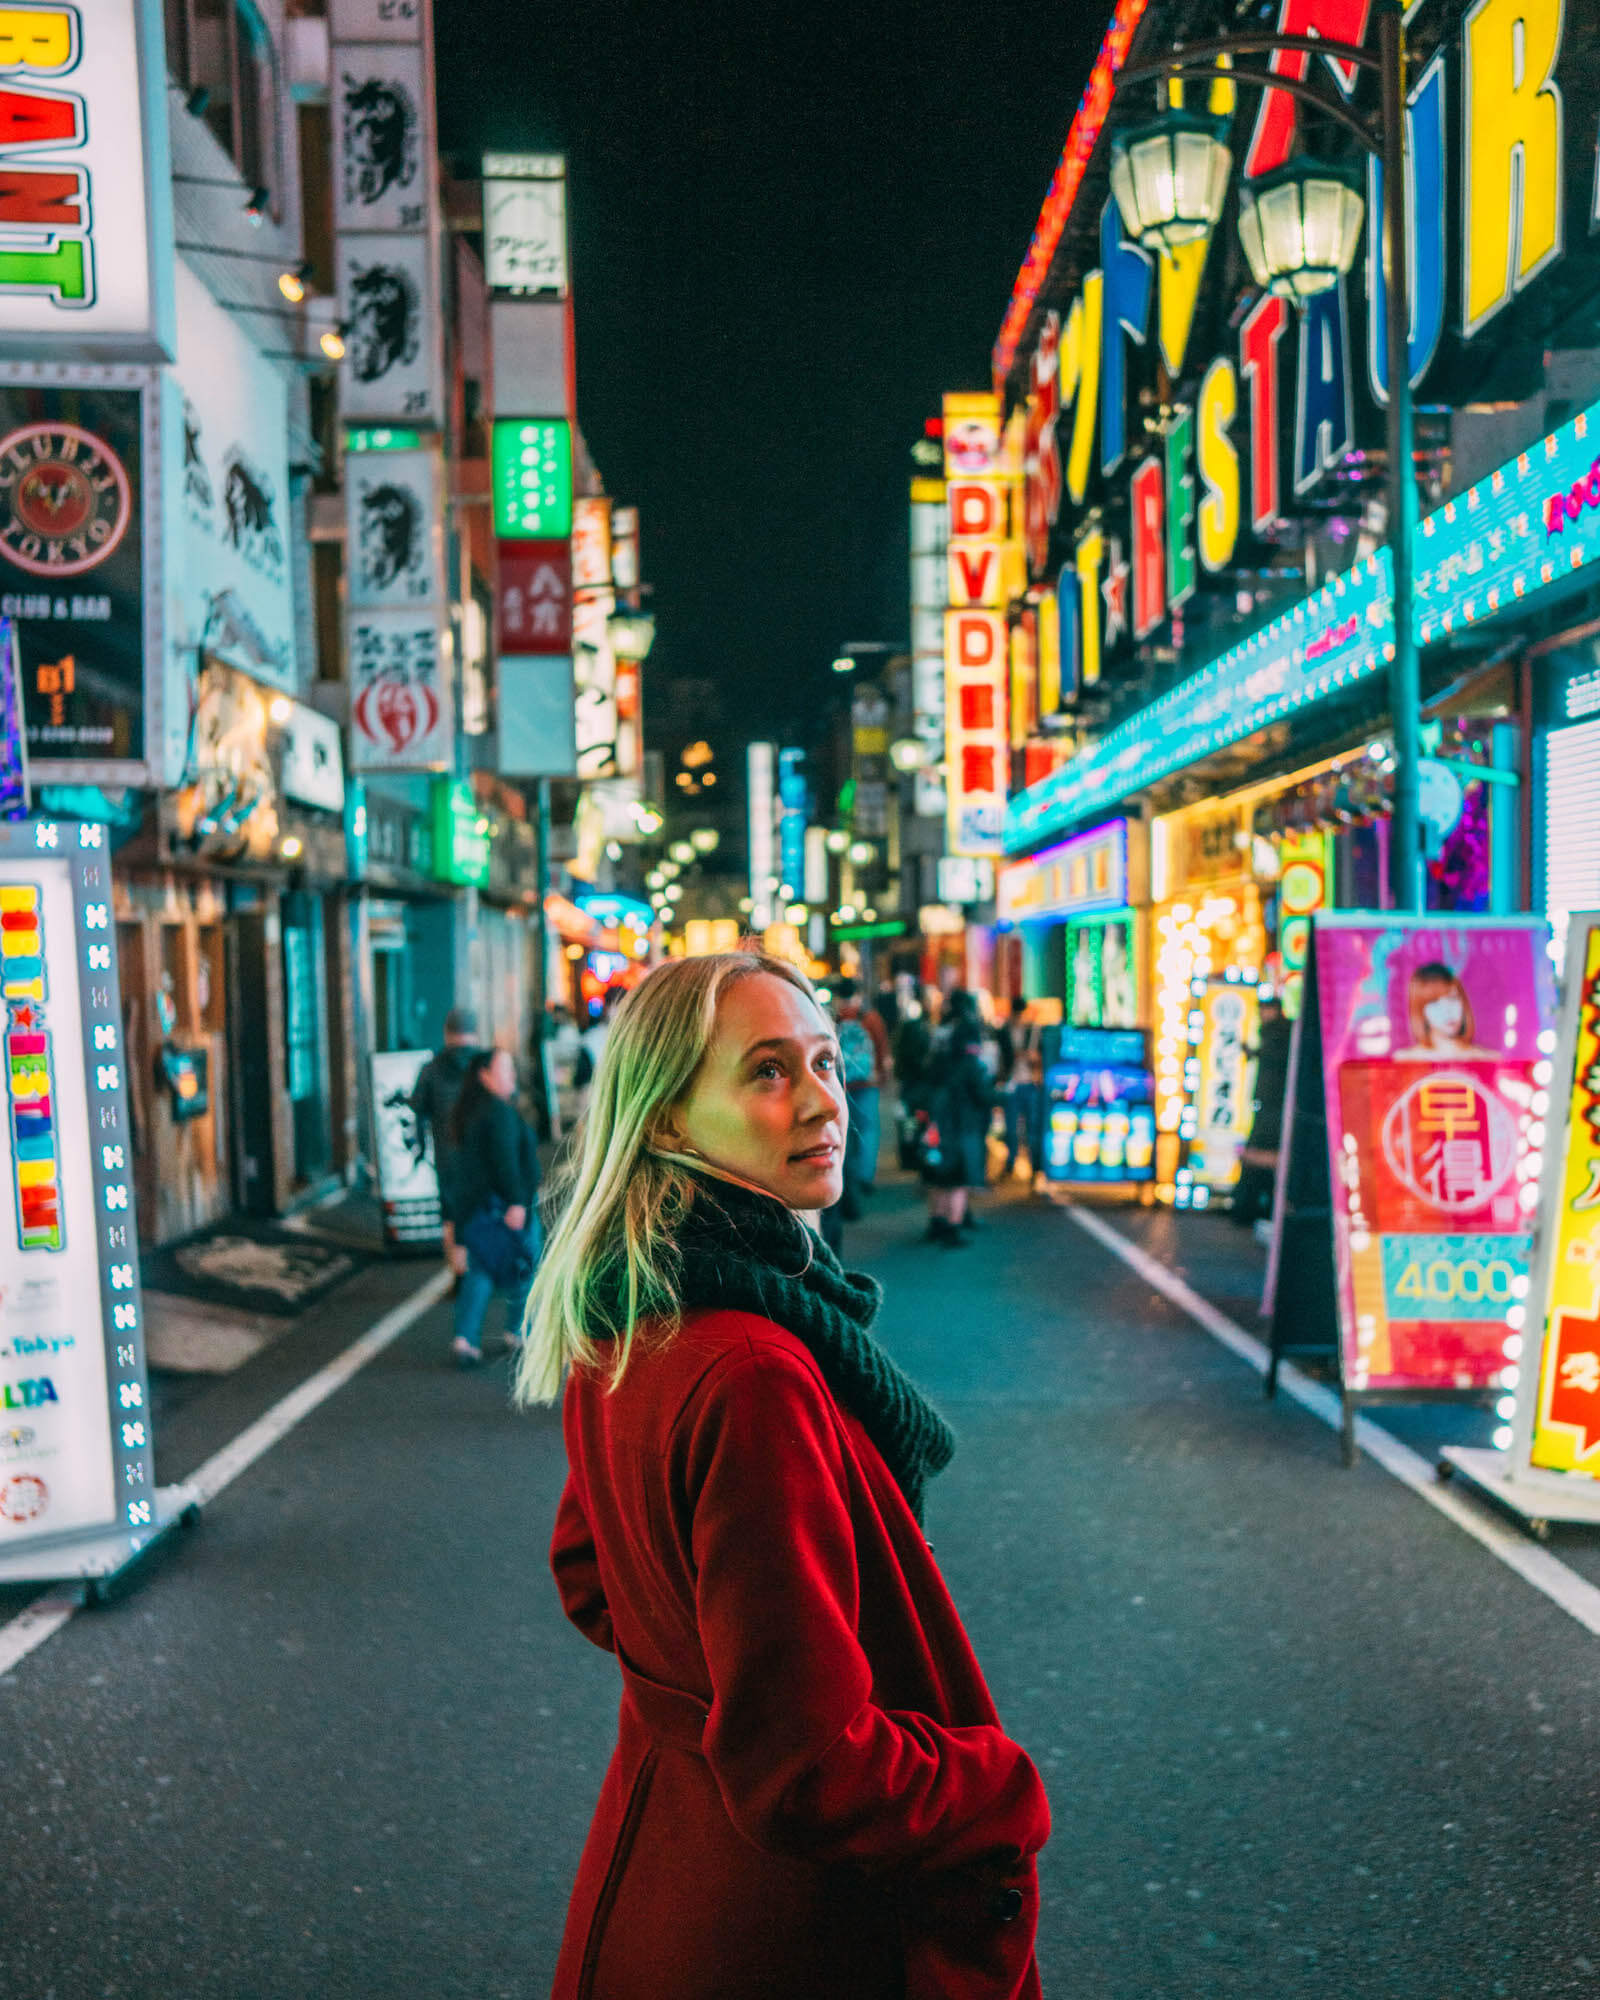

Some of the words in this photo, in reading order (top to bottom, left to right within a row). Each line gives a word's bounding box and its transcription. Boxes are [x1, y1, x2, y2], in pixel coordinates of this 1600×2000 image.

[1419, 1078, 1491, 1204] 早得
[1395, 1260, 1515, 1303] 4000
[0, 1377, 59, 1410] LTA
